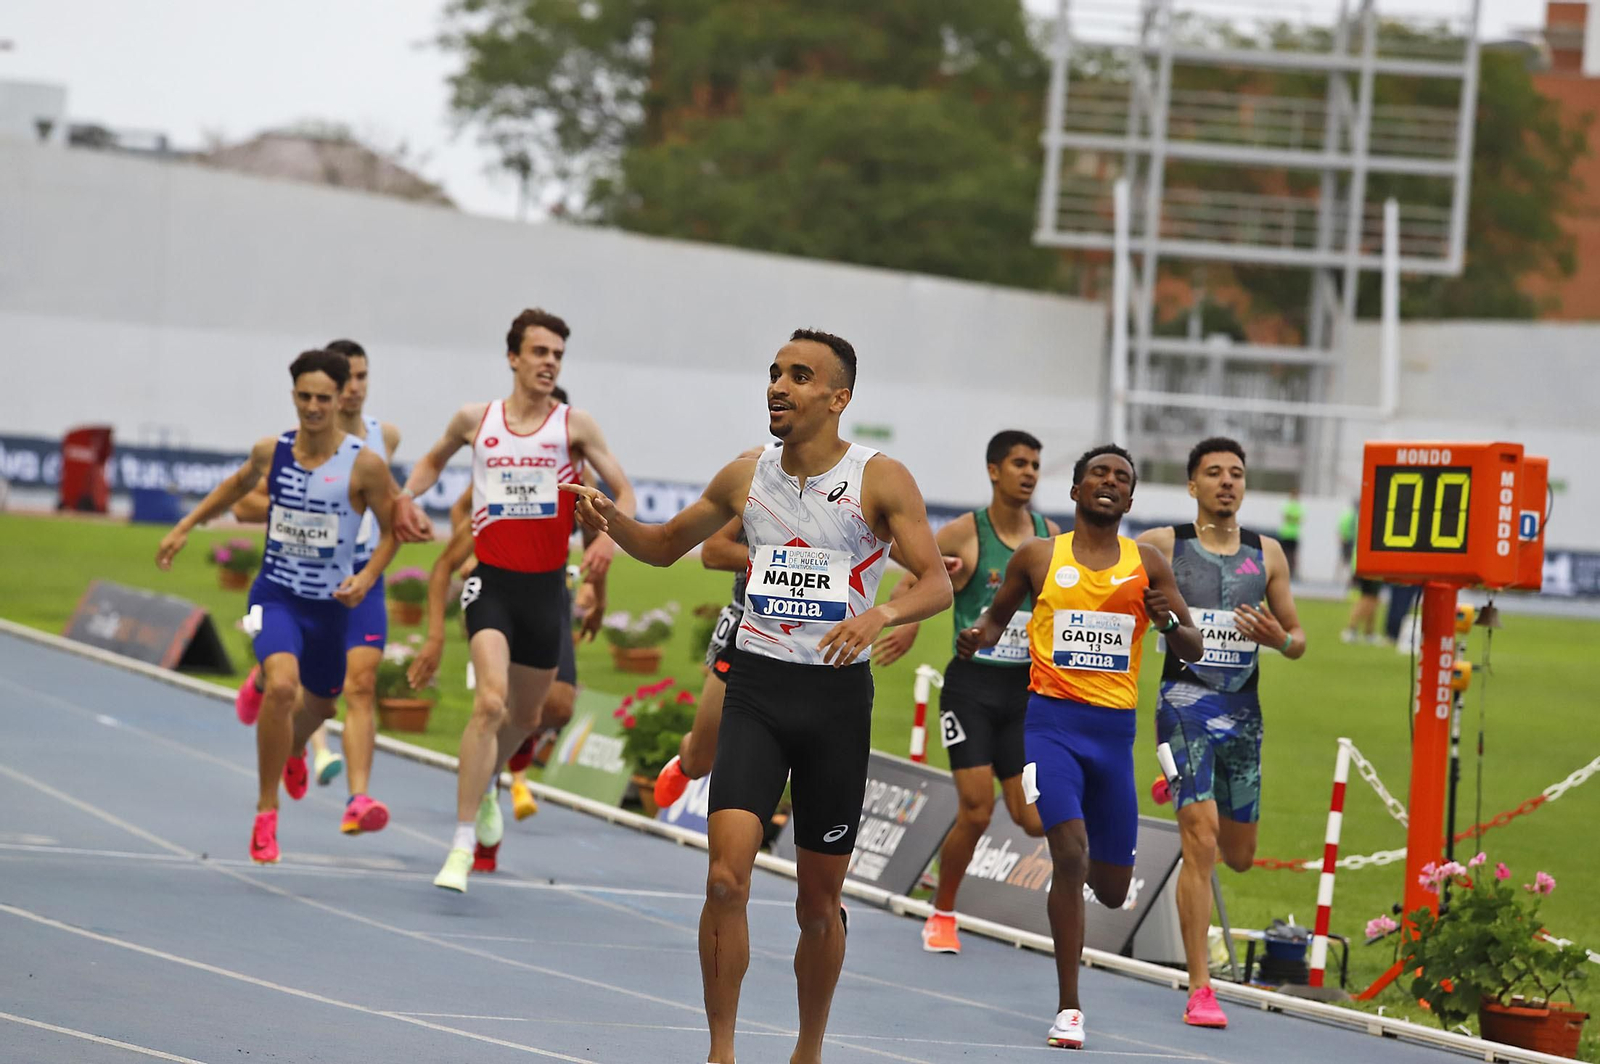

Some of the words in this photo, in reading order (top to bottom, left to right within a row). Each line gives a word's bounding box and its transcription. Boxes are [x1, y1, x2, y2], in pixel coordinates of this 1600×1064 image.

[1397, 449, 1451, 465] MONDO
[506, 486, 536, 494] SISK
[1383, 473, 1470, 548] 00
[1497, 471, 1514, 556] MONDO
[763, 570, 830, 589] NADER
[790, 587, 804, 598] 14
[1062, 630, 1123, 645] GADISA
[1089, 644, 1101, 652] 13
[1436, 637, 1453, 719] MONDO
